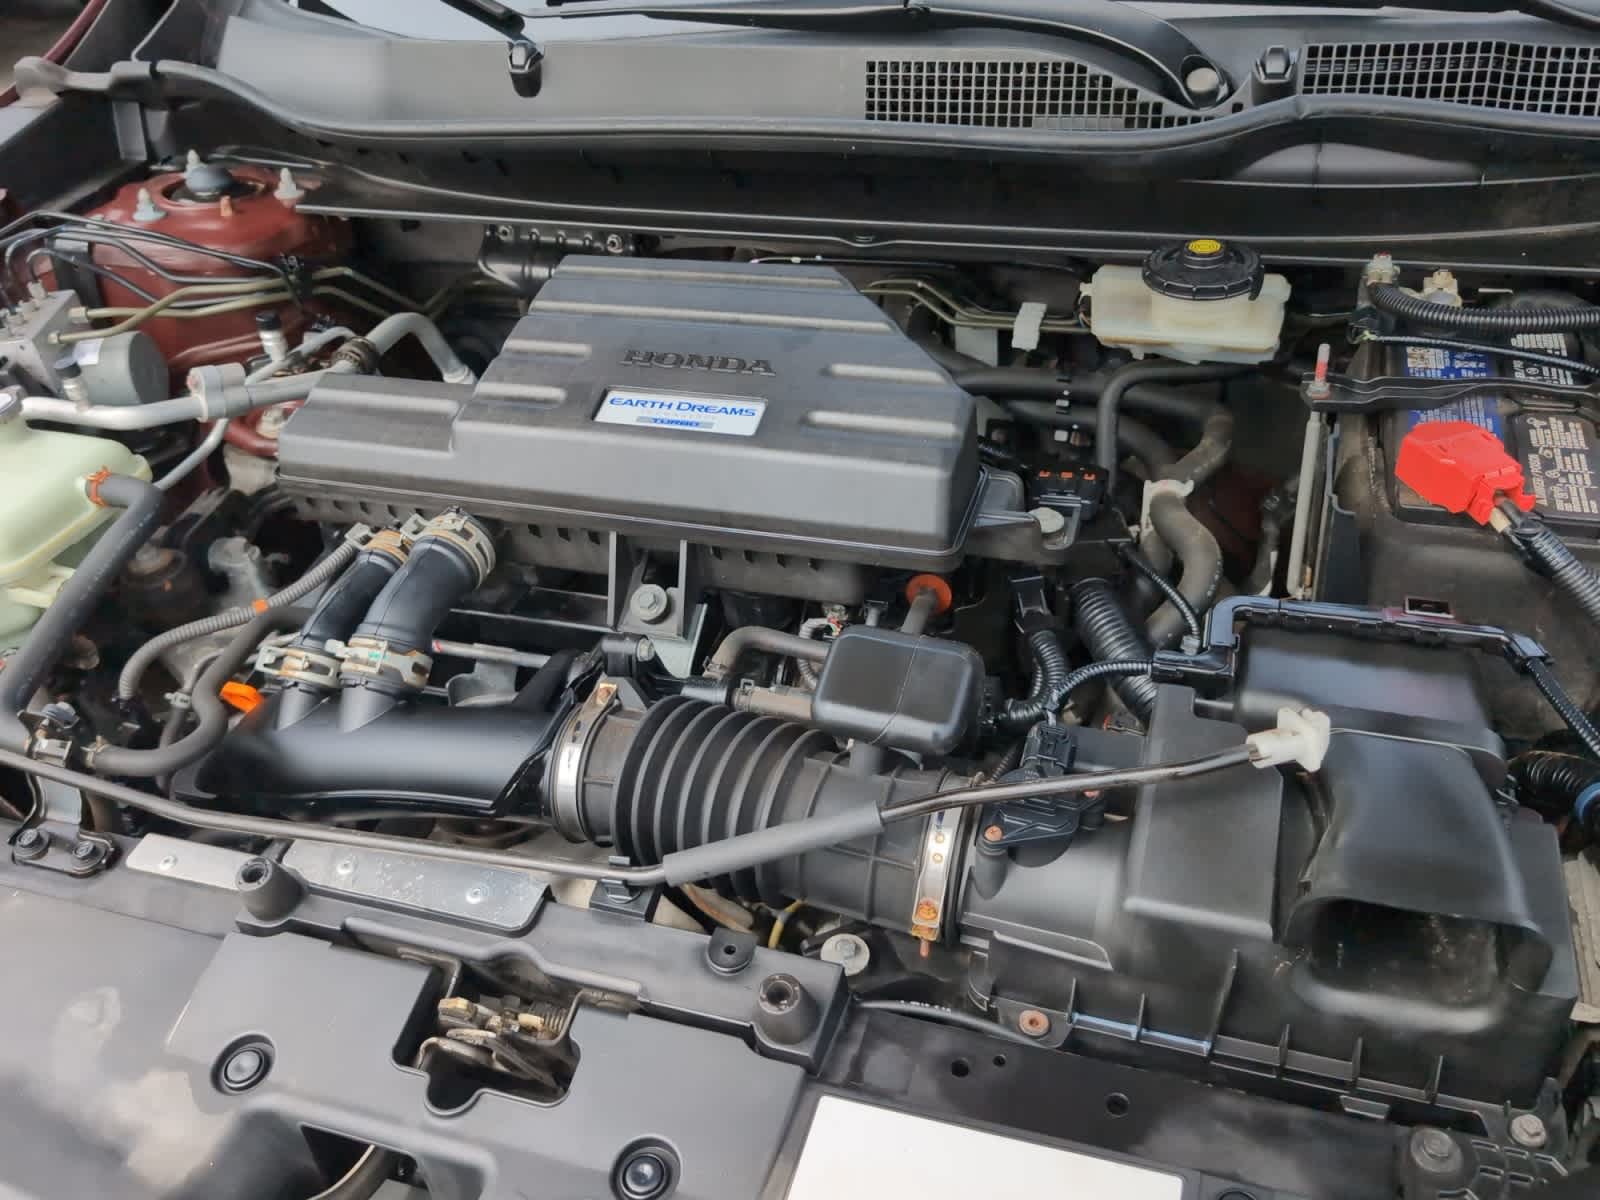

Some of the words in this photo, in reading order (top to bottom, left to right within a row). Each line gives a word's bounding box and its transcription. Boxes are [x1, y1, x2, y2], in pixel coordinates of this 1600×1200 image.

[619, 350, 776, 376] HONDA
[609, 397, 673, 411] EARTH
[676, 401, 757, 417] DREAMS
